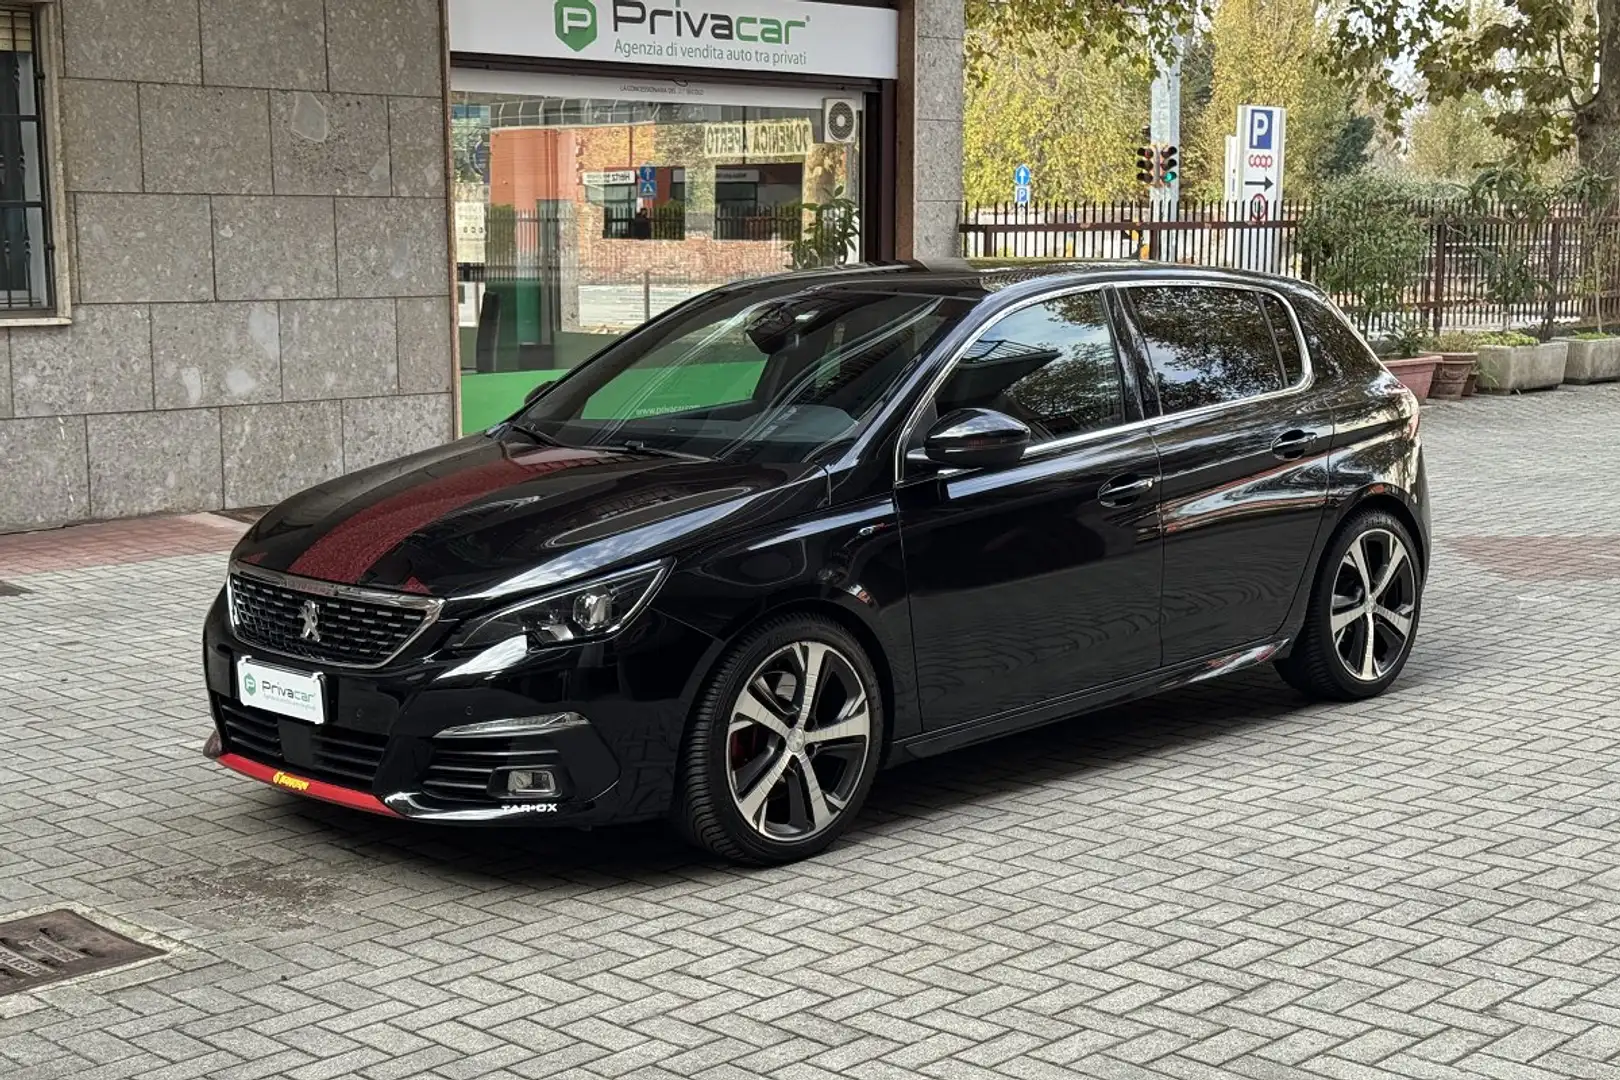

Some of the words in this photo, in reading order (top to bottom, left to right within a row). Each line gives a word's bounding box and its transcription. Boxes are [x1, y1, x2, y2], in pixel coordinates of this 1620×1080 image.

[563, 7, 592, 34] P
[612, 0, 806, 45] Privacar
[614, 38, 663, 58] Agenzia
[666, 41, 678, 56] di
[680, 44, 723, 60] vendita
[726, 49, 752, 61] auto
[755, 50, 770, 63] tra
[772, 50, 807, 67] privati
[1252, 112, 1269, 147] P
[262, 680, 317, 703] Privacar
